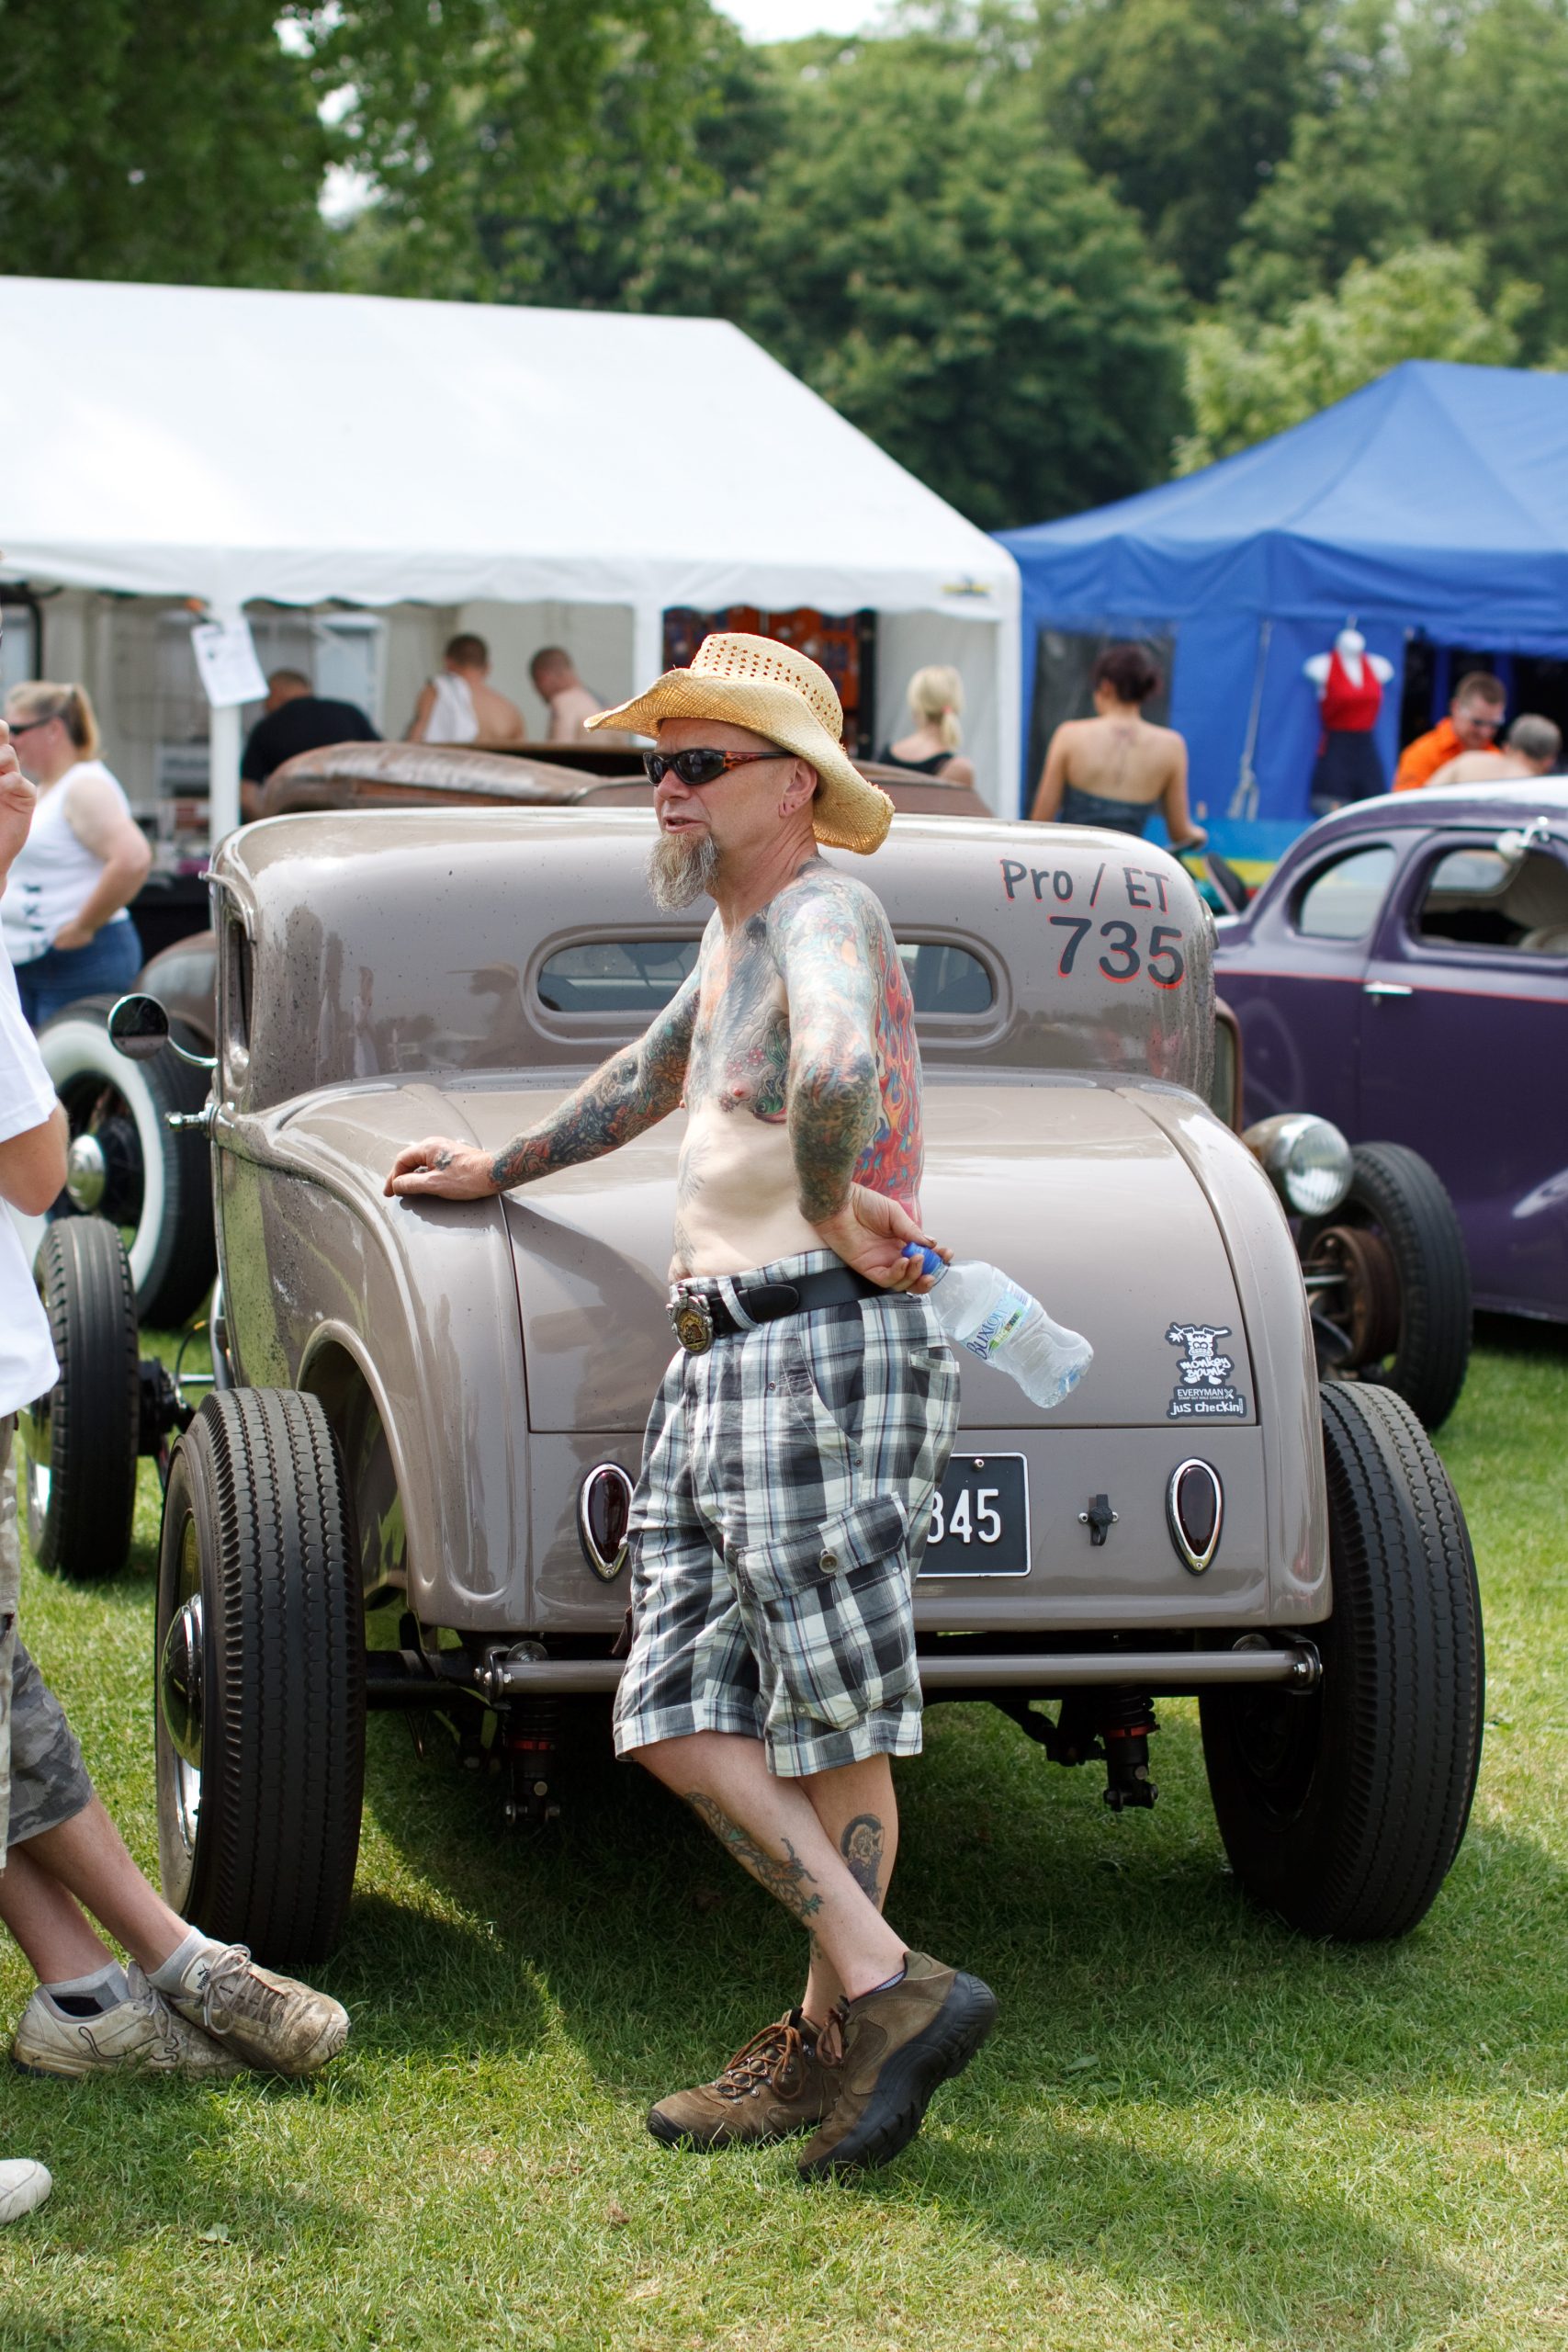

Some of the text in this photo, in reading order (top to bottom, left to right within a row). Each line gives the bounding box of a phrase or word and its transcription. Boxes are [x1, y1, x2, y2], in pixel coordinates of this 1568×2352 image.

[1000, 859, 1074, 903] Pro
[1122, 866, 1169, 914] ET
[1048, 916, 1185, 989] 735
[1170, 1402, 1191, 1416] jus
[1177, 1388, 1224, 1396] EVERYMAN
